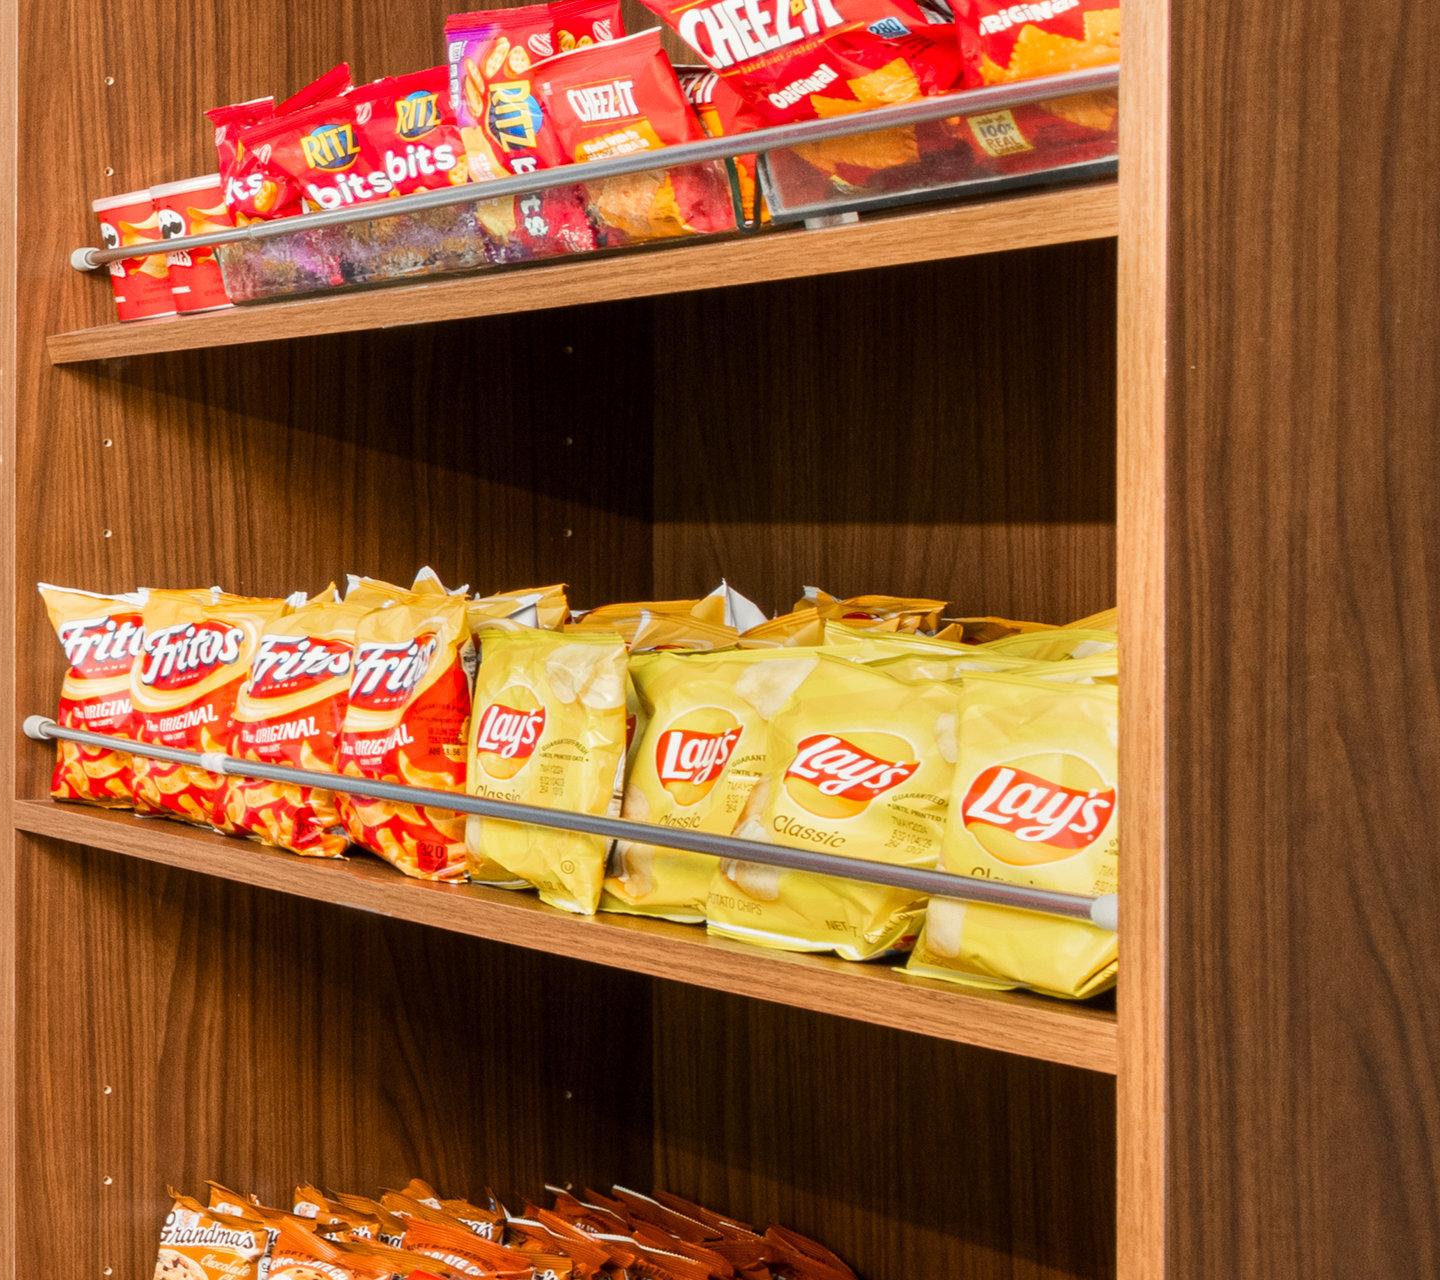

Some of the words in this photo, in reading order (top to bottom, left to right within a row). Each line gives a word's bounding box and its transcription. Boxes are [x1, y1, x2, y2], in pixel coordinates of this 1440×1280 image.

[395, 94, 443, 142] RITZ
[486, 80, 537, 152] RITZ
[300, 122, 362, 170] RITZ
[986, 136, 1021, 149] REAL
[385, 143, 457, 184] bits
[308, 173, 394, 210] bits
[142, 623, 244, 685] Fritos
[146, 719, 159, 733] The
[159, 703, 220, 732] ORIGINAL
[242, 730, 254, 744] The
[254, 716, 320, 743] ORIGINAL
[478, 706, 543, 759] Lay's
[341, 741, 354, 756] The
[354, 724, 414, 756] ORIGINAL
[662, 729, 739, 785] Lay's
[795, 735, 913, 794] Lay's
[967, 767, 1111, 842] Lay's
[773, 814, 846, 848] Classic
[707, 891, 734, 908] POTATO
[737, 898, 762, 915] CHIPS
[161, 1211, 255, 1250] Grandma's
[201, 1254, 252, 1276] Chocolate
